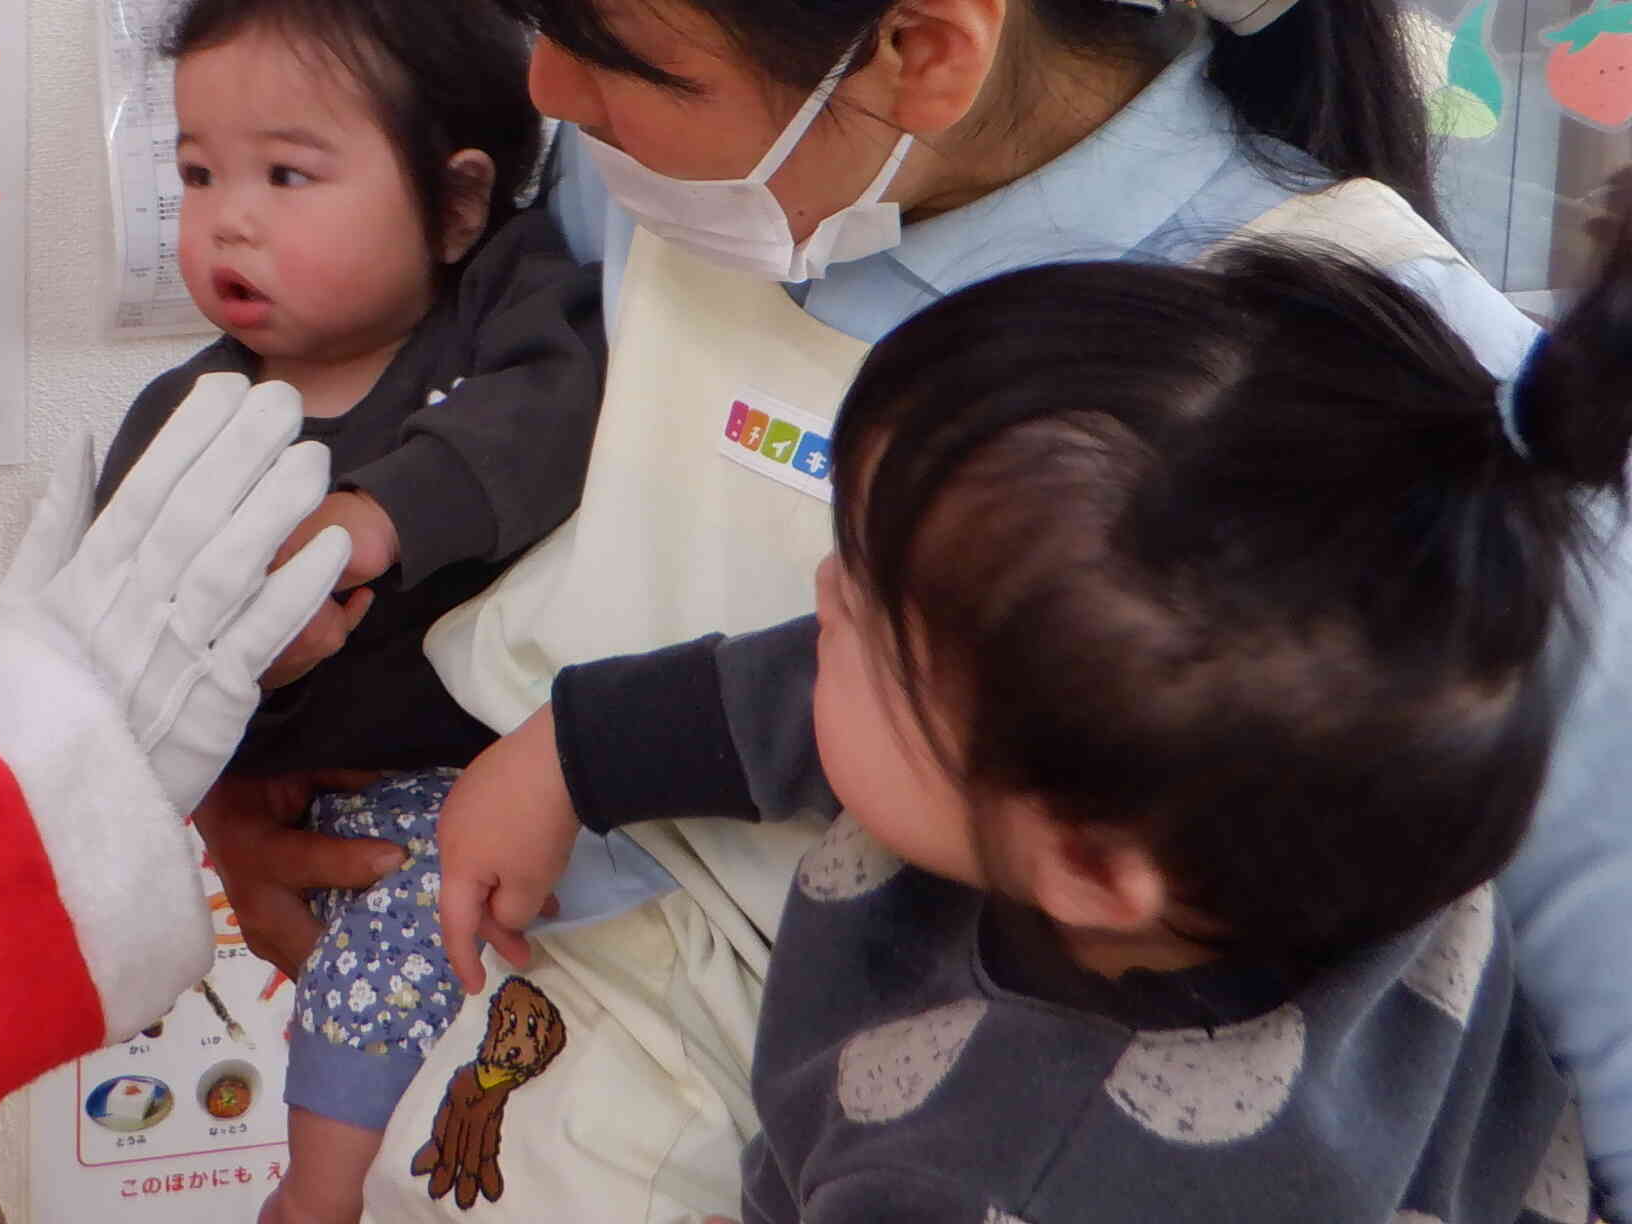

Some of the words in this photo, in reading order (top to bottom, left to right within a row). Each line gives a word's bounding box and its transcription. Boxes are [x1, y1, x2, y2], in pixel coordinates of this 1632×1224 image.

[121, 1165, 253, 1198] このほかにも
